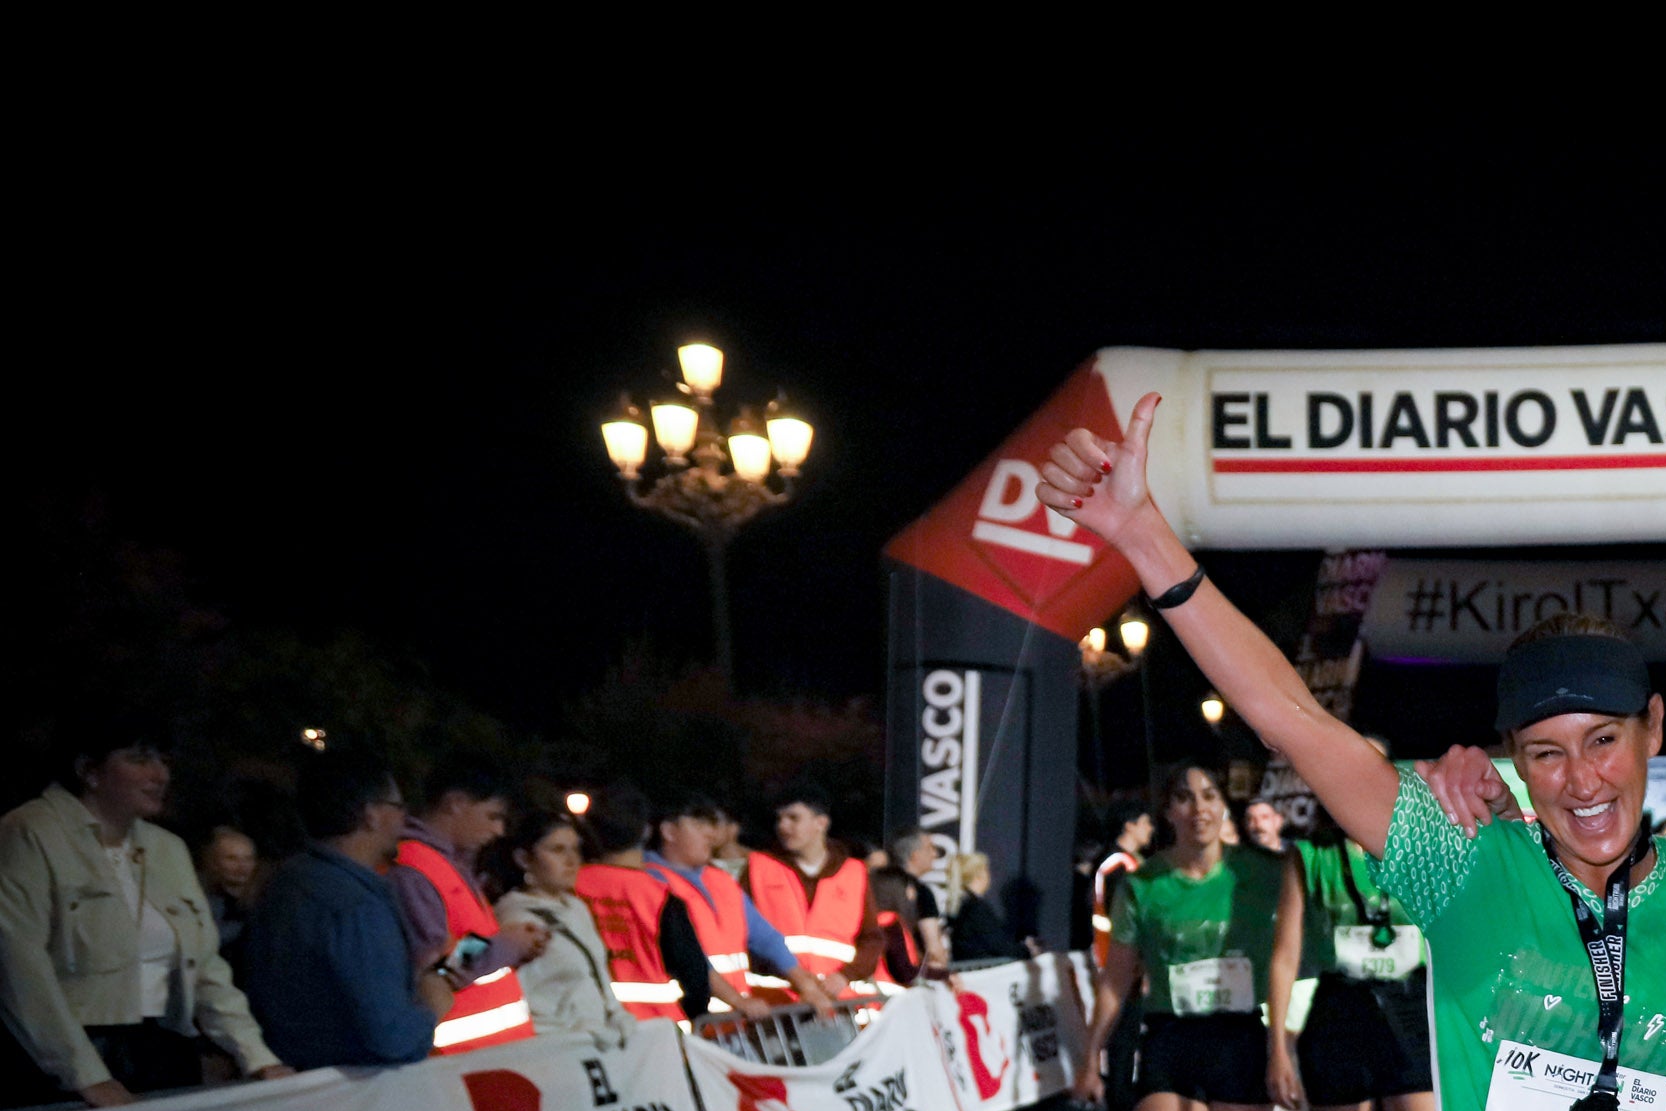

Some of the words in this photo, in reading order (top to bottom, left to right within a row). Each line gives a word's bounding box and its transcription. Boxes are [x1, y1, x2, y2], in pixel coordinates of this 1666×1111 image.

[1212, 392, 1291, 449] EL
[1308, 389, 1557, 449] DIARIO
[919, 669, 963, 828] VASCO
[1587, 940, 1617, 1001] FINISHER
[1503, 1047, 1541, 1077] 10K
[582, 1059, 617, 1106] EL
[1630, 1093, 1655, 1104] VASCO
[1631, 1085, 1657, 1097] DIARIO
[1633, 1078, 1642, 1087] EL
